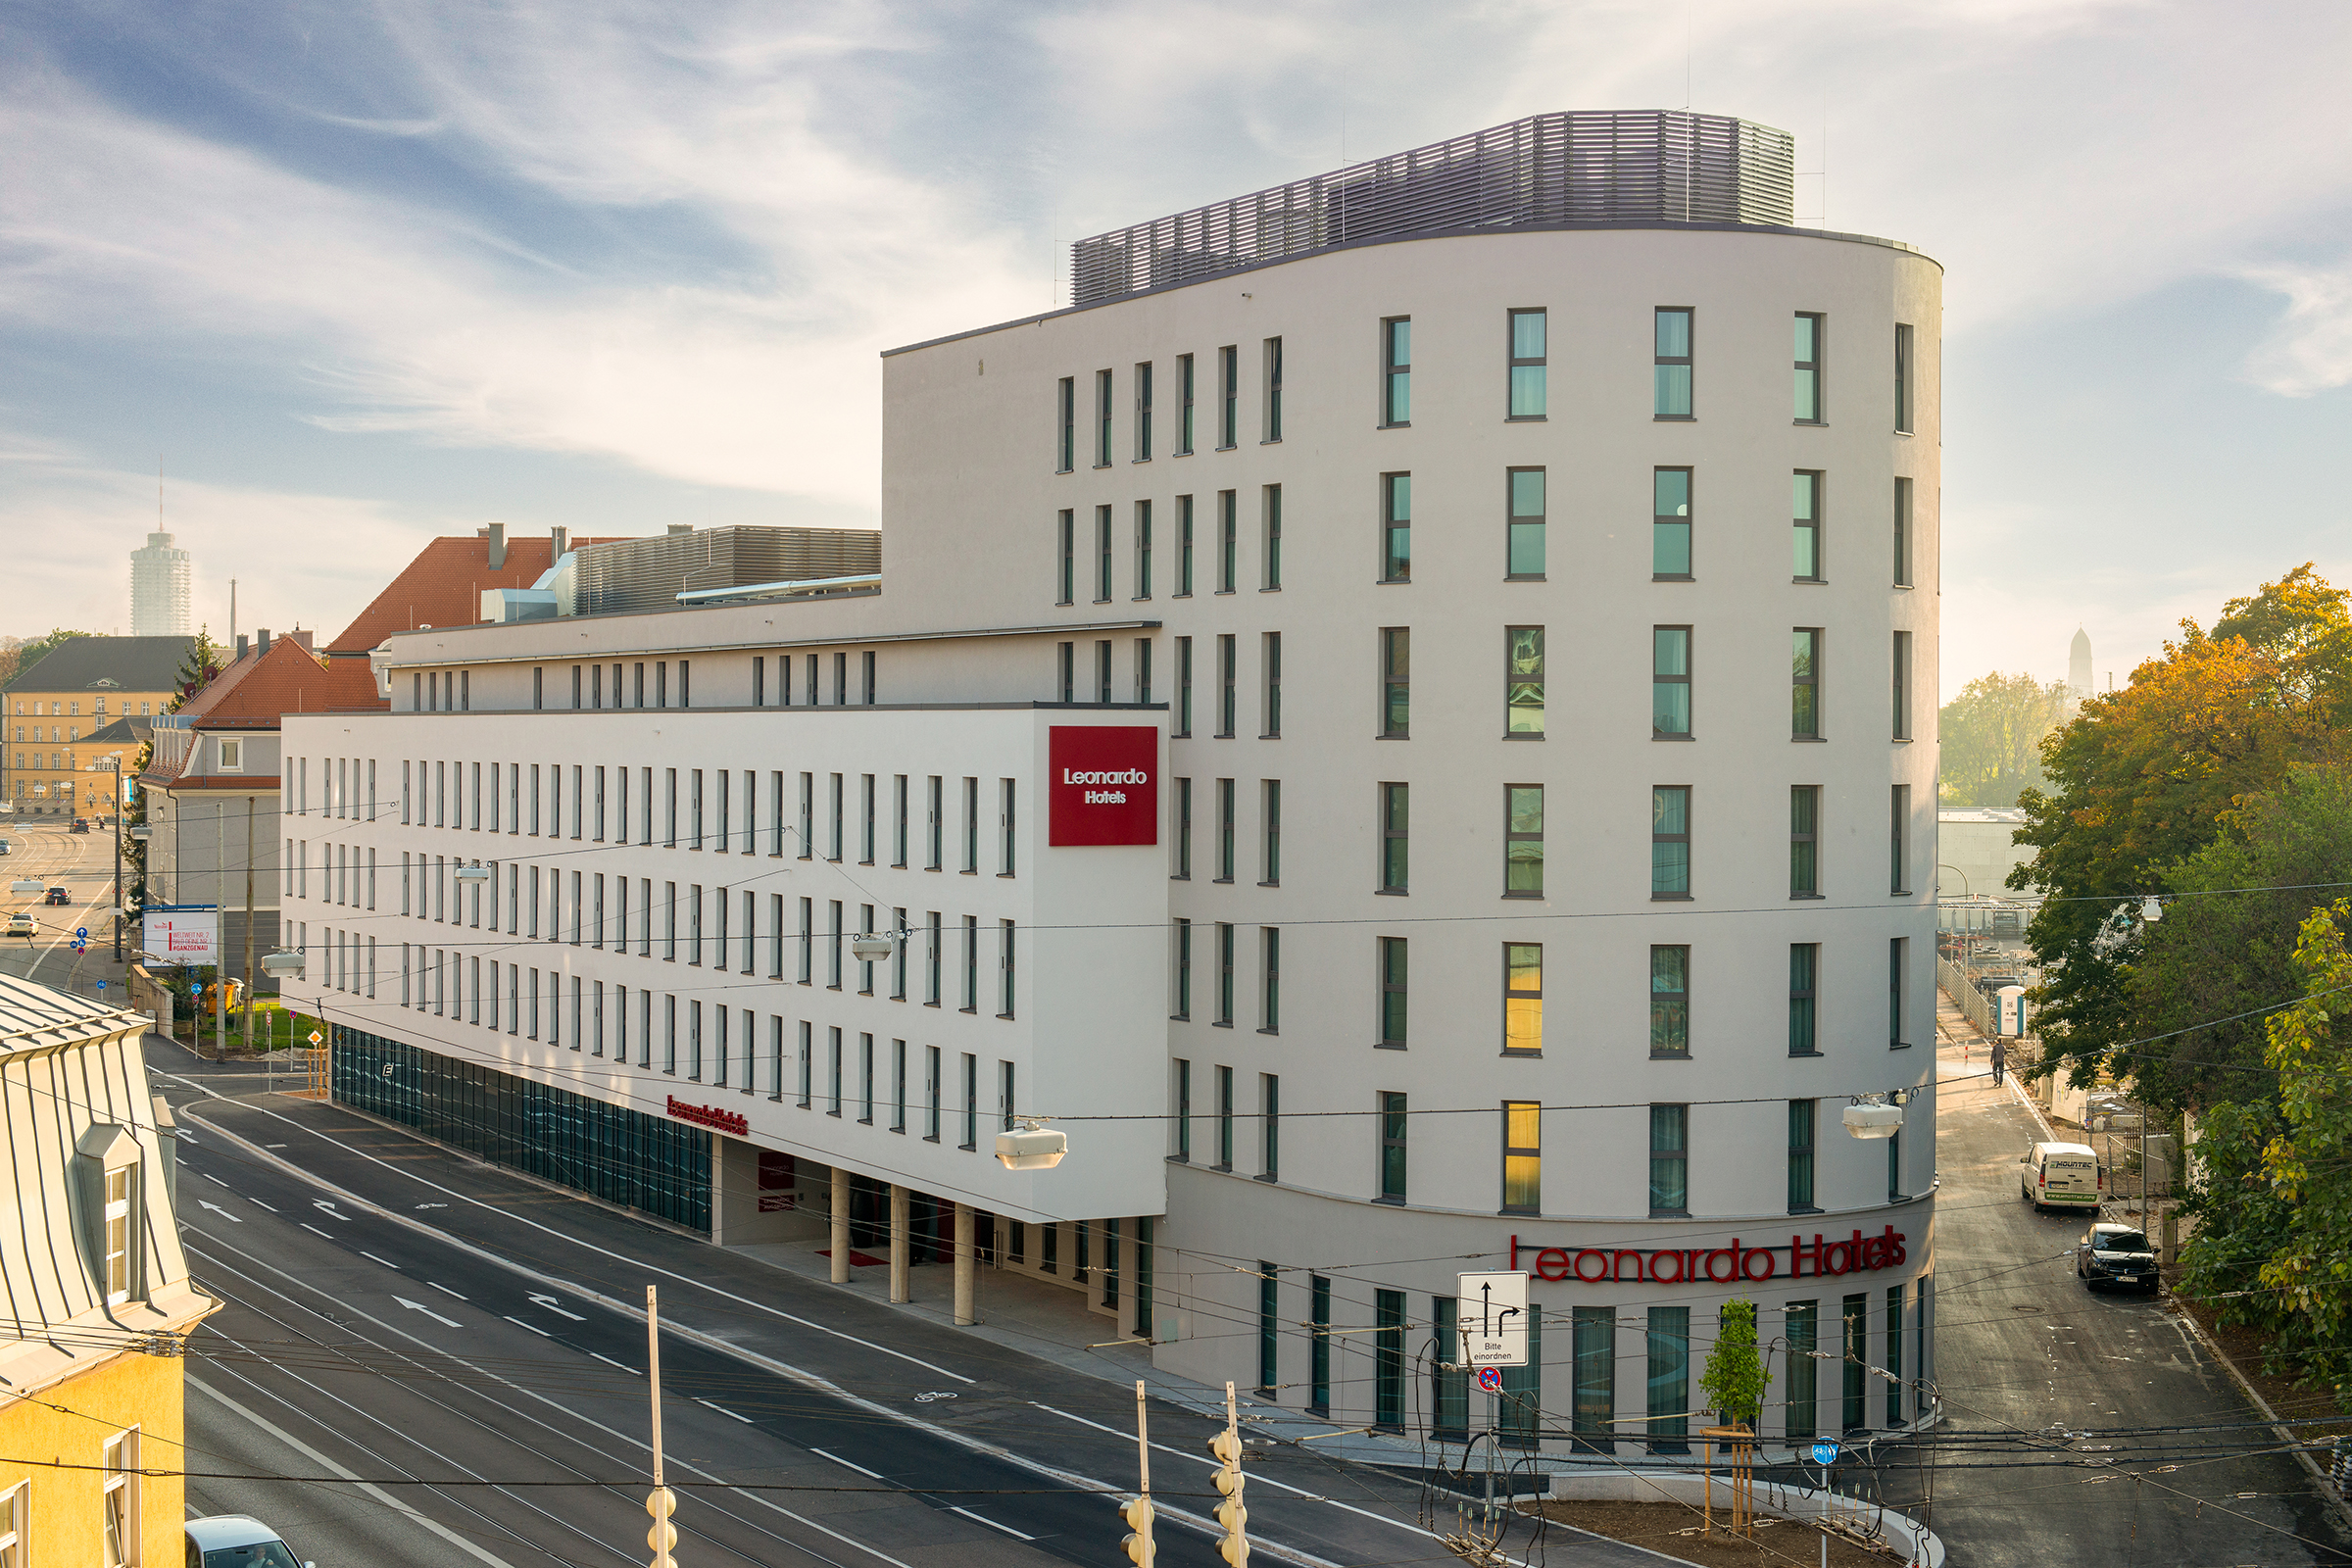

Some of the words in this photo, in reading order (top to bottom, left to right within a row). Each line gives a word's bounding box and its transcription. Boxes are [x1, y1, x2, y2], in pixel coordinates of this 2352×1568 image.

[1063, 767, 1148, 785] Leonardo
[1084, 790, 1127, 805] Hotels
[1510, 1234, 1775, 1284] Leonardo
[1791, 1225, 1906, 1279] Hotels
